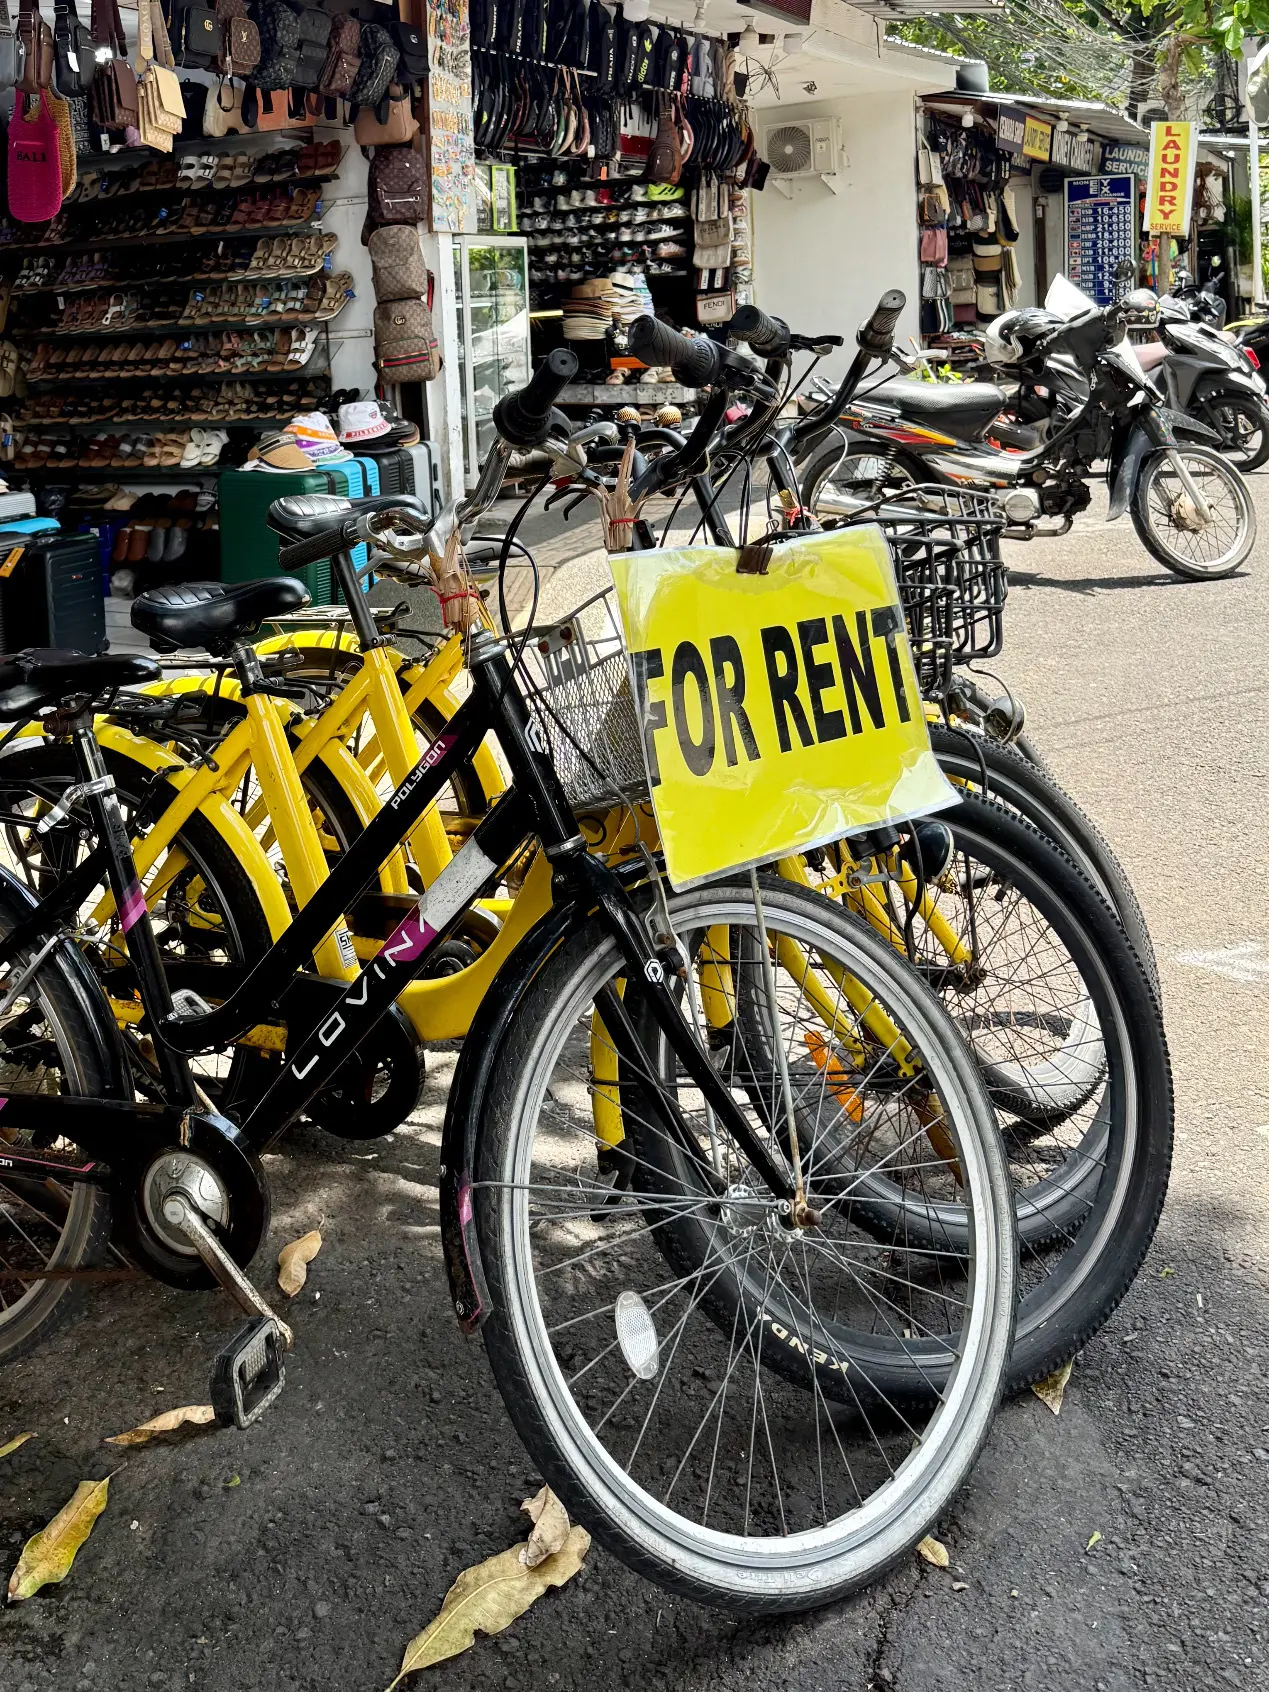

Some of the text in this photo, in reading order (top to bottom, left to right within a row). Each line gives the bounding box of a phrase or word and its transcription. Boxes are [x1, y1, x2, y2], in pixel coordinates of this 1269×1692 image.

[607, 48, 615, 81] PRADA
[16, 151, 48, 162] BALI
[1105, 146, 1149, 163] LAUNDR
[1157, 125, 1182, 220] LAUNDRY
[1097, 206, 1130, 214] 16.450
[1097, 214, 1130, 222] 10.650
[1097, 223, 1130, 231] 21.650
[1150, 222, 1181, 231] SERVICE
[1097, 231, 1130, 239] 18.950
[1097, 239, 1130, 247] 20.400
[1097, 247, 1130, 255] 11.600
[703, 300, 725, 310] FENDI
[630, 604, 912, 788] FOR RENT
[390, 740, 446, 810] POLYGON
